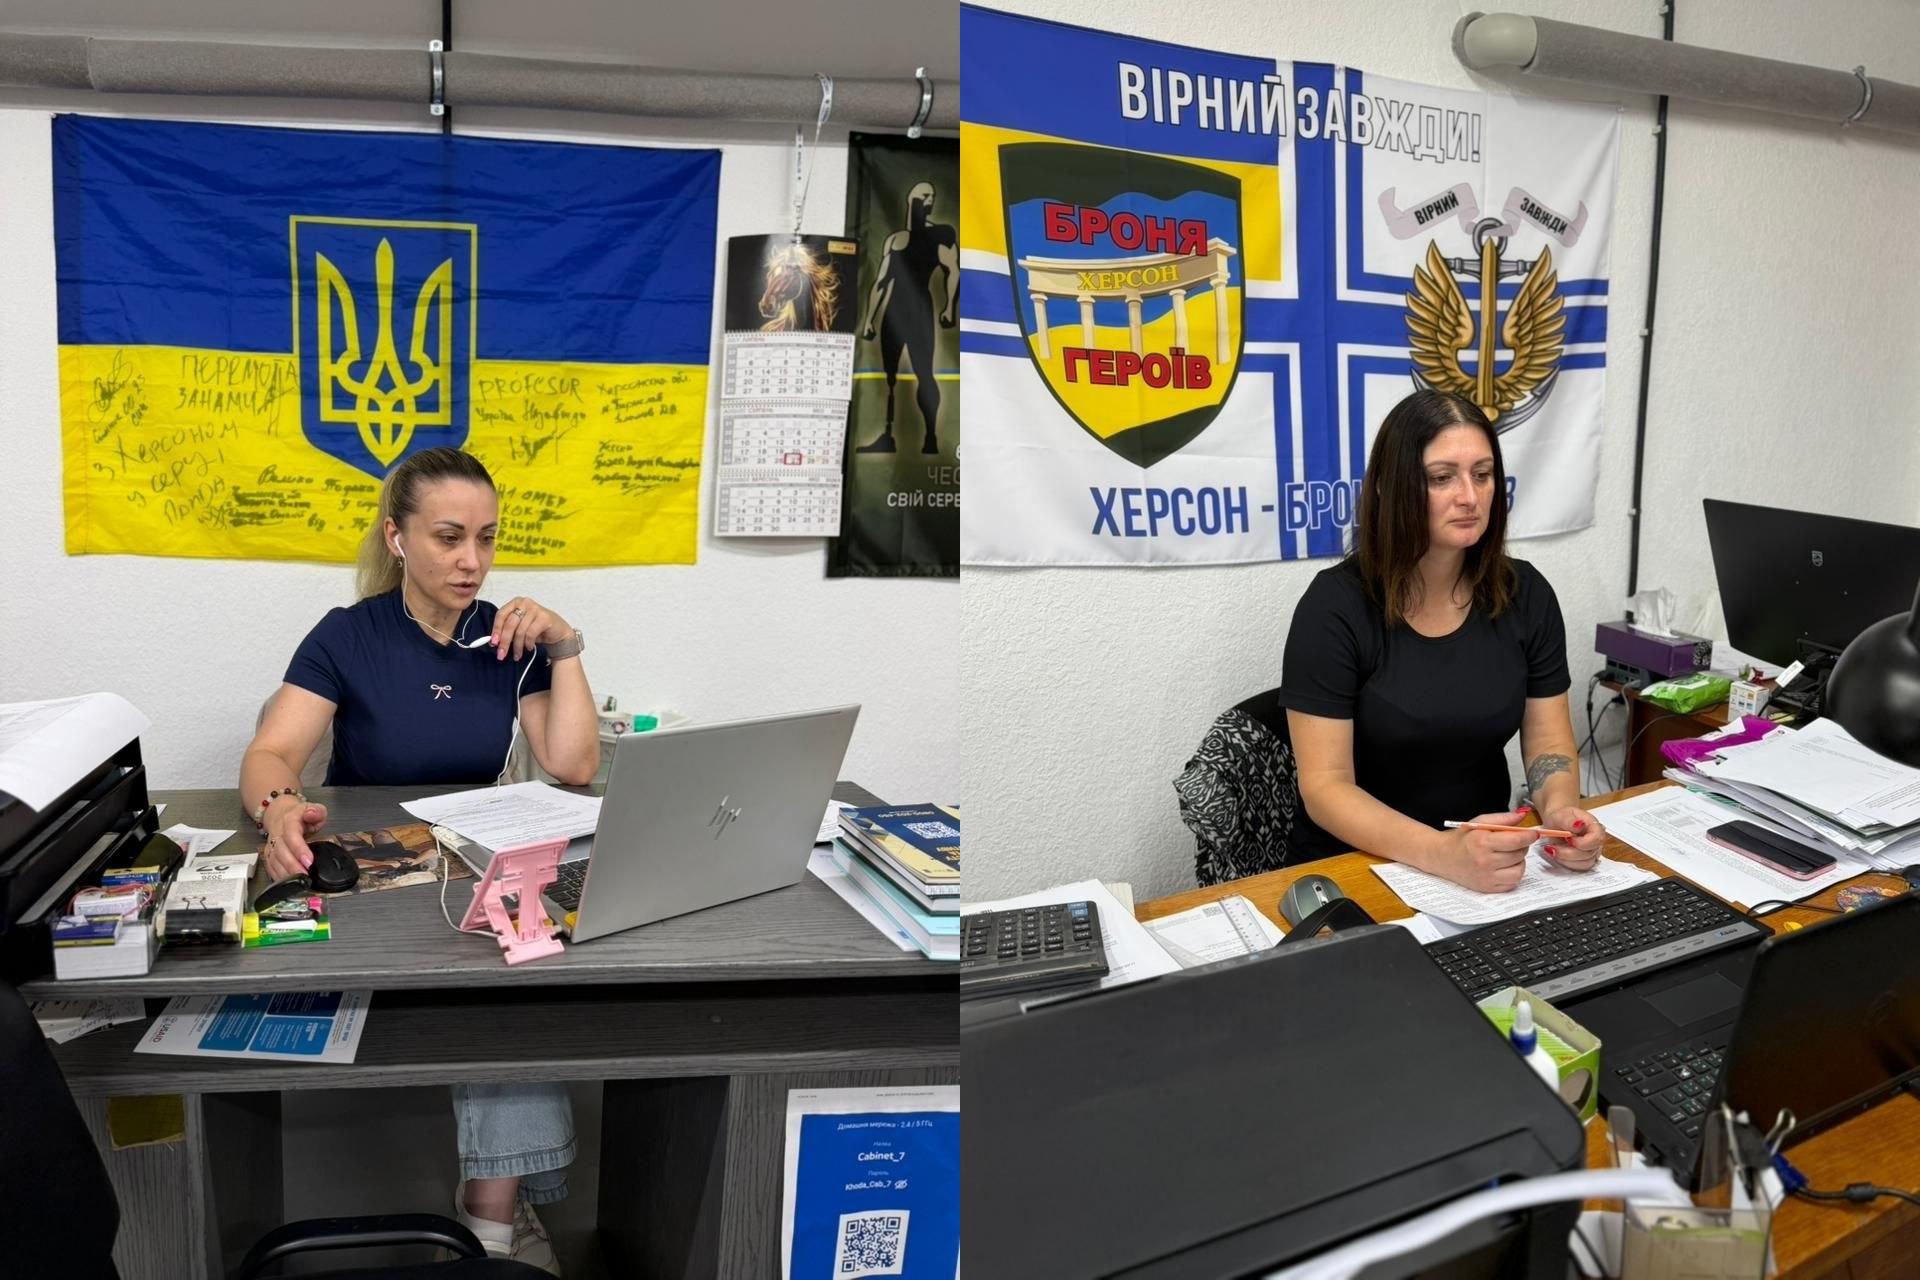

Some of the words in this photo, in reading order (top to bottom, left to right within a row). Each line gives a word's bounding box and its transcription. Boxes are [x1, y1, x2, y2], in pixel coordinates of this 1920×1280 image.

[1118, 61, 1288, 138] ВІРНИЙ
[1297, 86, 1481, 164] ЗАВЖДИ!
[1414, 190, 1460, 226] ВІРНИЙ
[1520, 196, 1569, 236] ЗАВЖДИ
[1043, 201, 1208, 257] БРОНЯ
[1077, 264, 1180, 291] ХЕРСОН
[1062, 346, 1213, 390] ГЕРОЇВ
[886, 488, 924, 508] СВІЙ
[1090, 485, 1250, 537] ХЕРСОН
[857, 1151, 906, 1162] Cabinet_7
